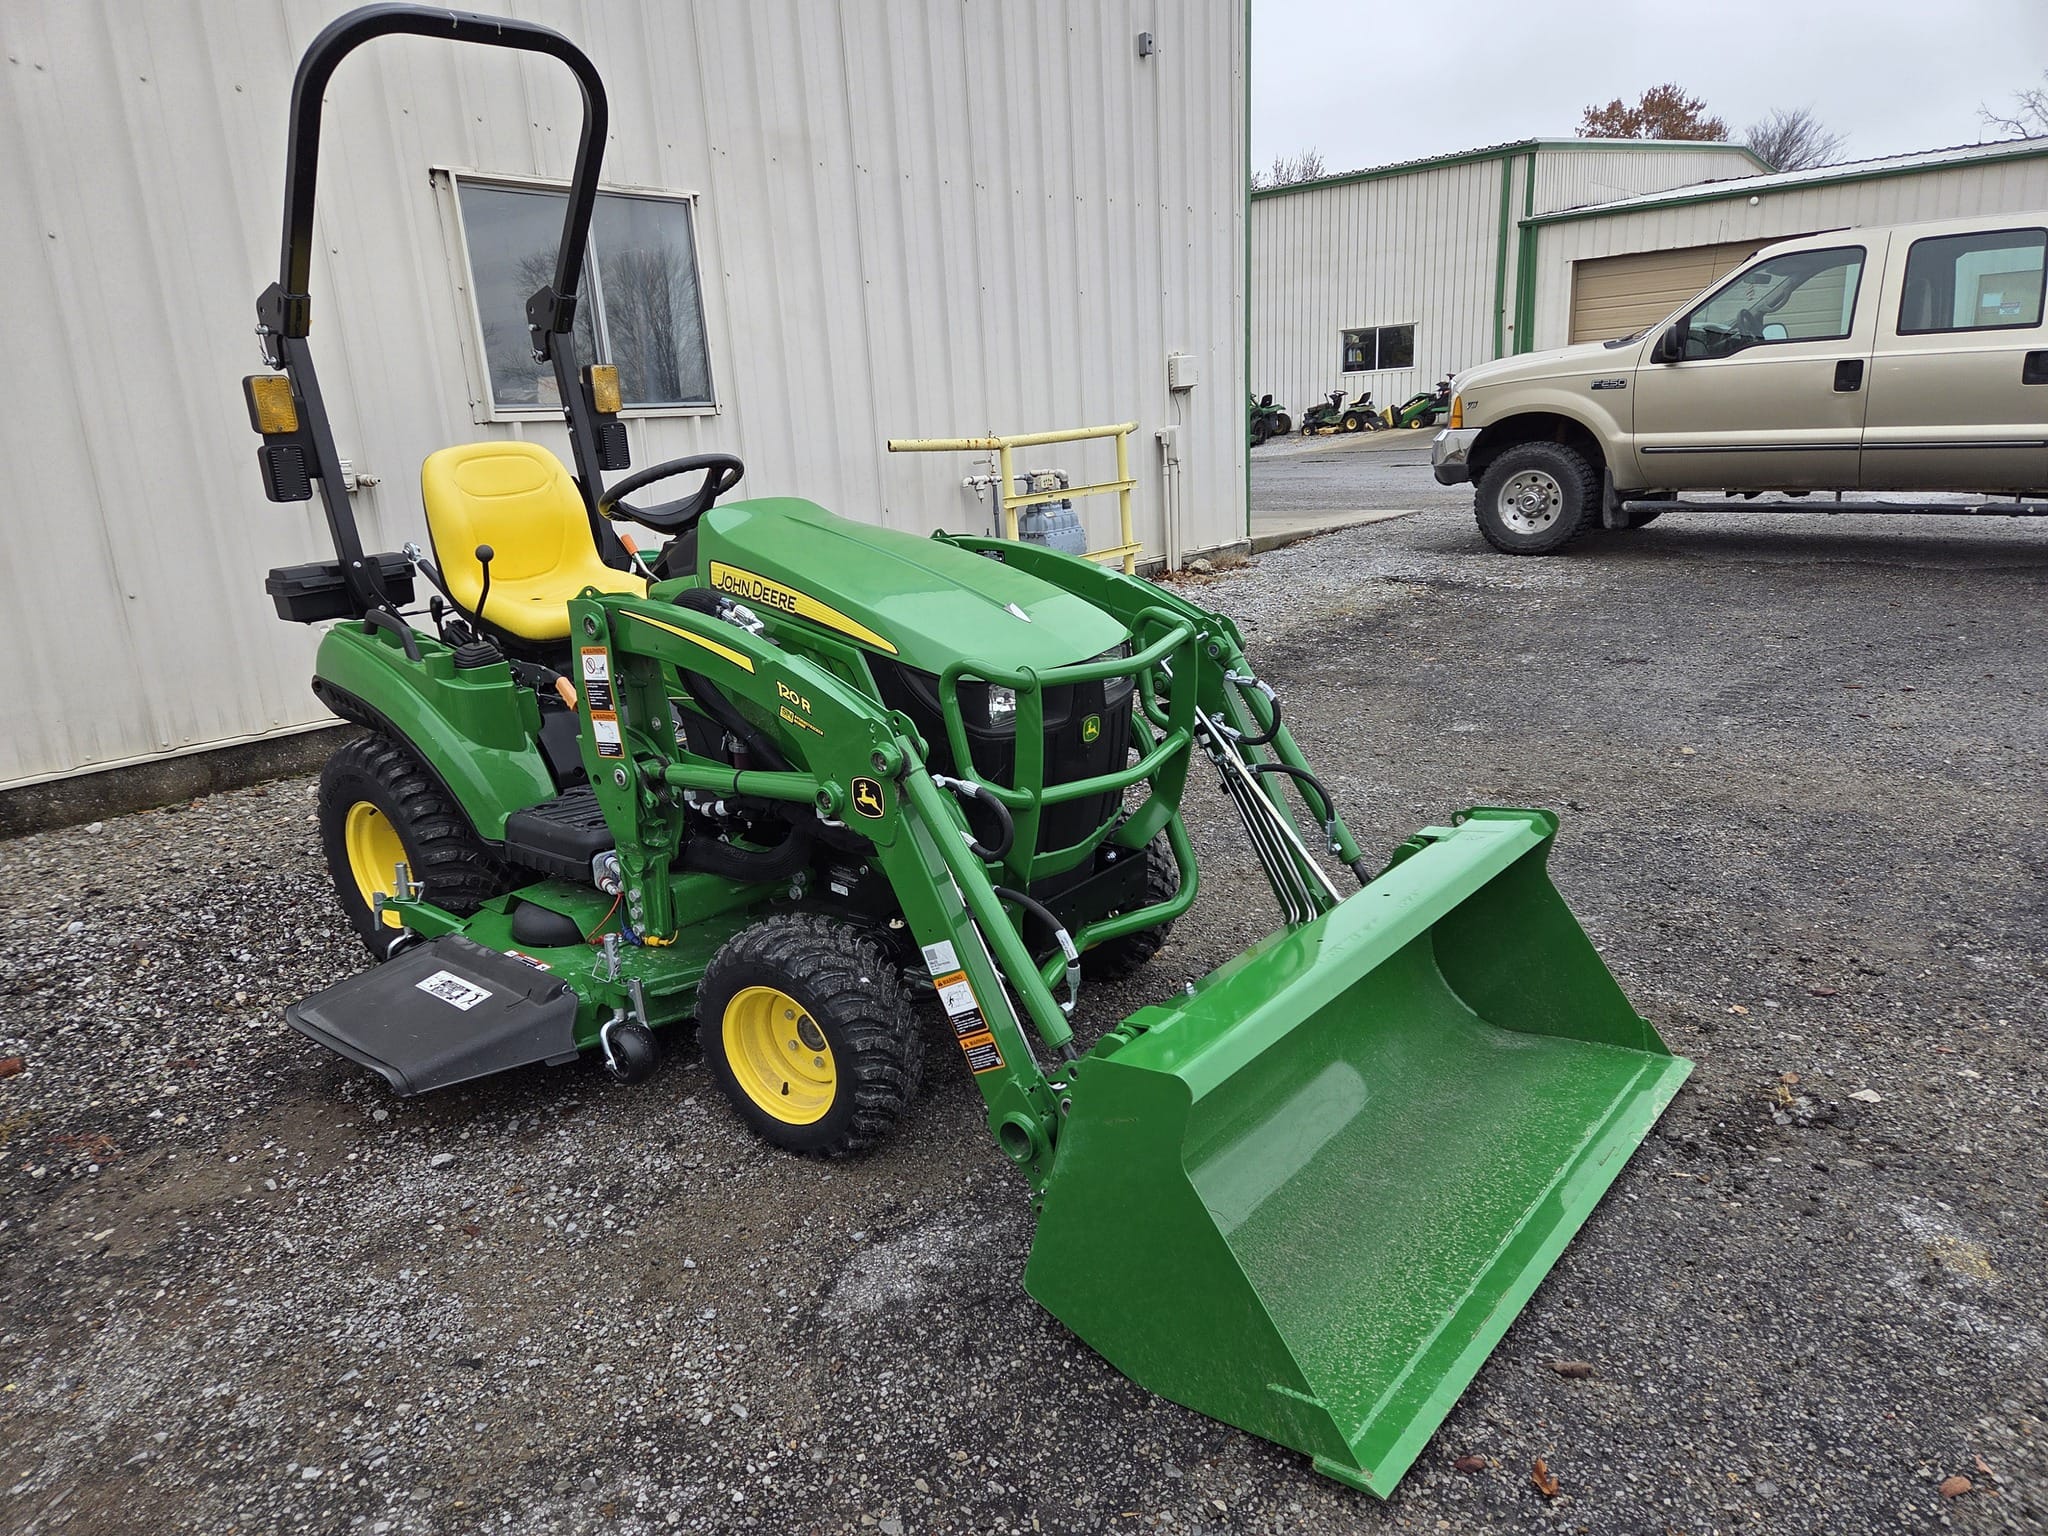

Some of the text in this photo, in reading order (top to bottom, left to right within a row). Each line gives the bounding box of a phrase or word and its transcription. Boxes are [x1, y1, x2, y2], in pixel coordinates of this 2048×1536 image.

[717, 571, 797, 611] JOHN DEERE
[943, 974, 963, 985] WARNING
[970, 1036, 990, 1046] WARNING
